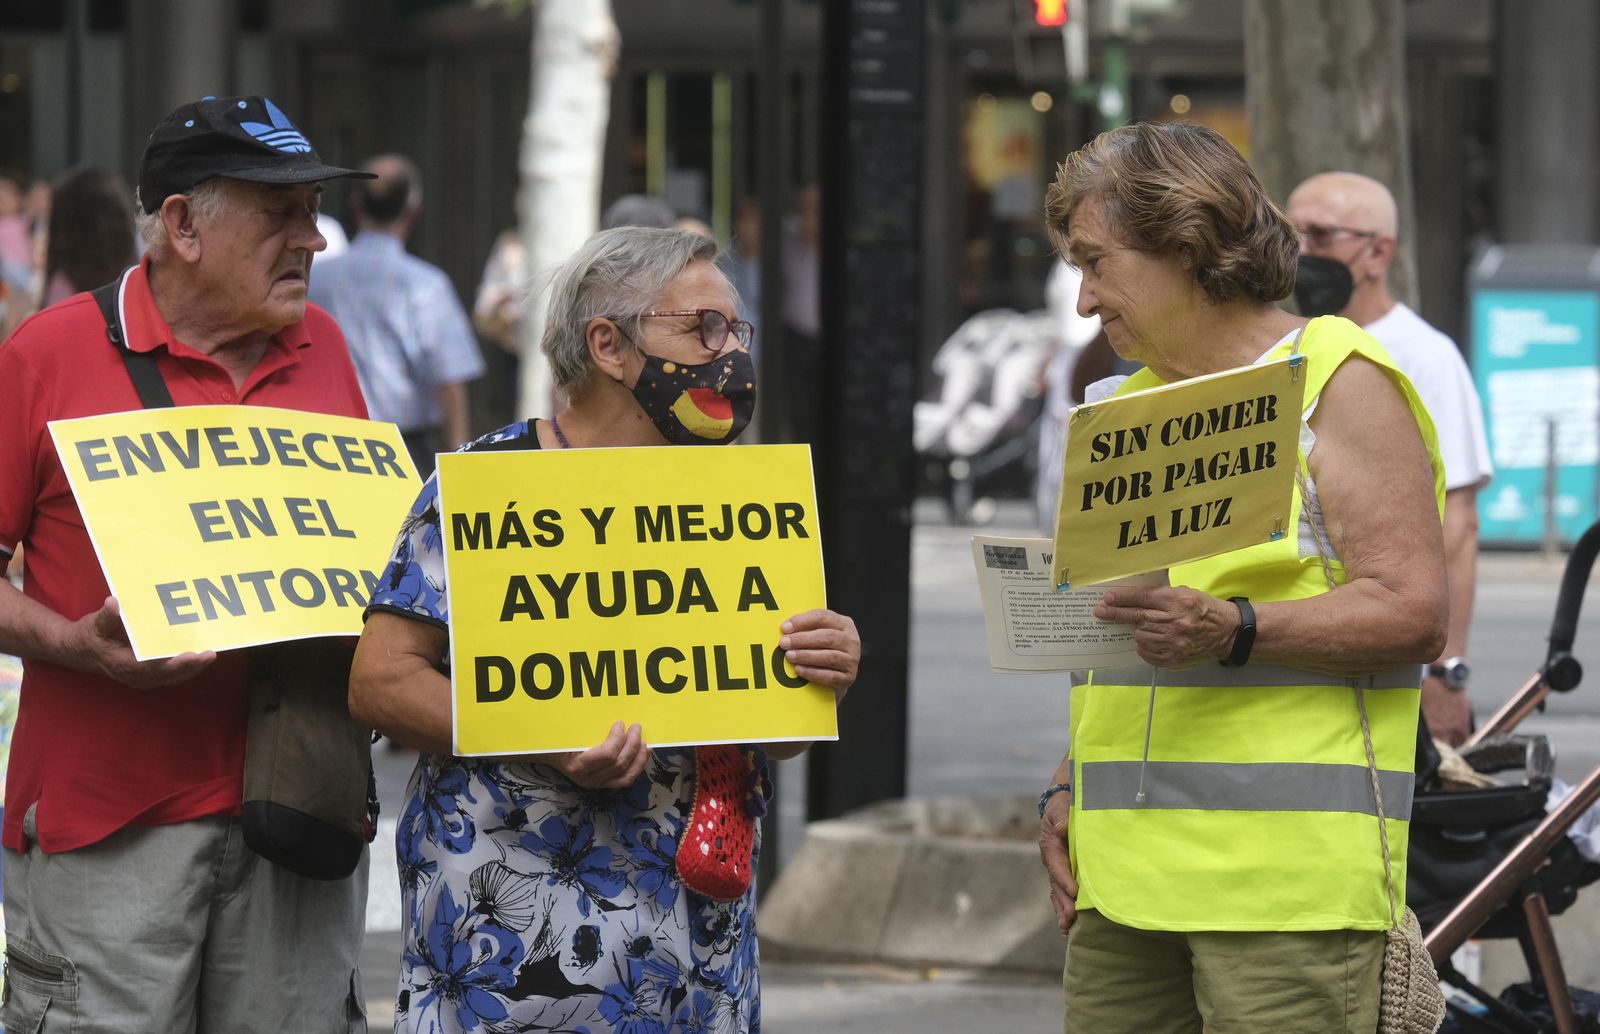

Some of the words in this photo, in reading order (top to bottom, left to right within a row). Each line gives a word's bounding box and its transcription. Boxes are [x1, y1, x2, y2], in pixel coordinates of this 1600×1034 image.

[74, 426, 408, 482] ENVEJECER
[1090, 423, 1152, 464] SIN
[1160, 394, 1278, 447] COMER
[1080, 470, 1153, 512] POR
[1162, 441, 1277, 493] PAGAR
[188, 497, 279, 543] EN
[283, 497, 357, 539] EL
[451, 501, 565, 551] MÁS
[580, 506, 616, 545] Y
[634, 502, 810, 543] MEJOR
[1116, 514, 1159, 550] LA
[1169, 496, 1233, 538] LUZ
[500, 568, 719, 622] AYUDA
[737, 566, 779, 612] A
